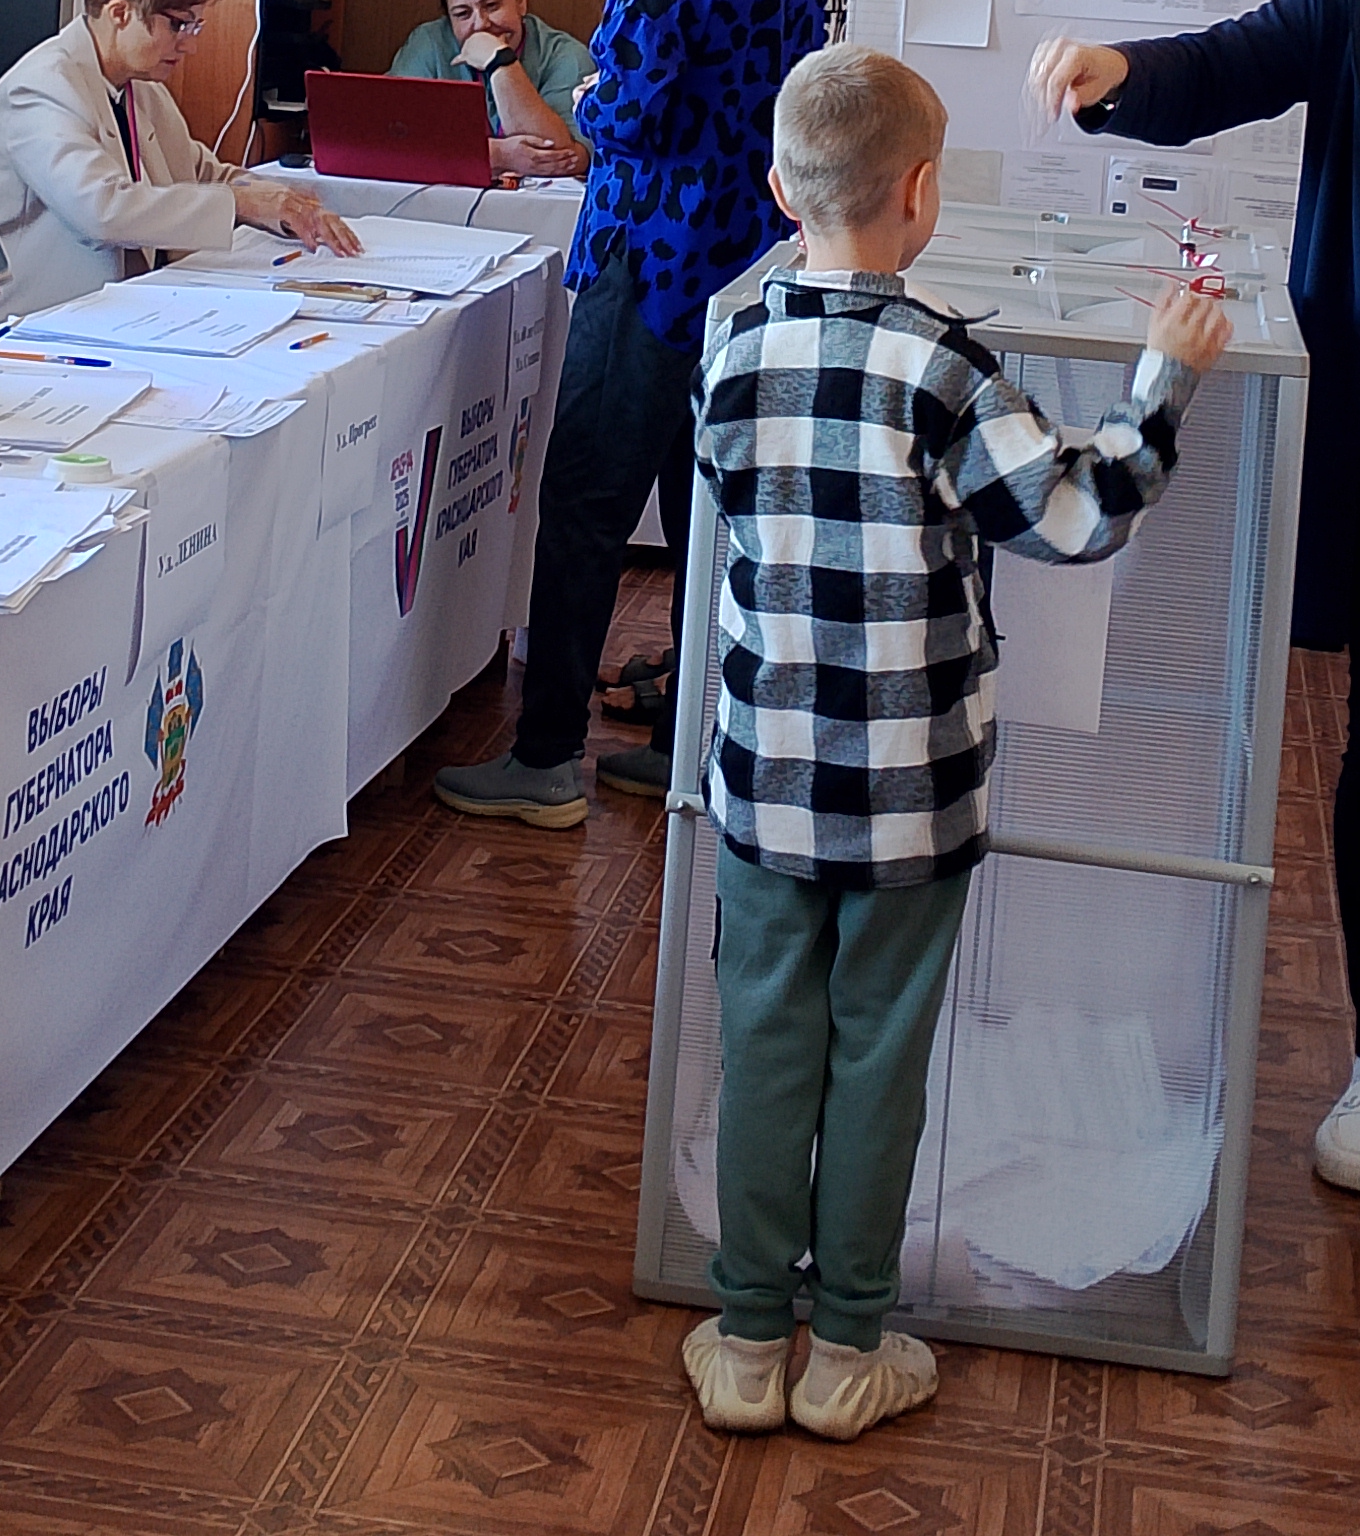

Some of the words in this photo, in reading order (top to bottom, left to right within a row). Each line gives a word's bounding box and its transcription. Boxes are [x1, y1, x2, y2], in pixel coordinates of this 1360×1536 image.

[179, 522, 217, 564] ЛЕНИНА
[27, 665, 107, 754] ВЫБОРЫ
[3, 719, 114, 840] ГУБЕРНАТОРА
[24, 874, 73, 949] КРАЯ
